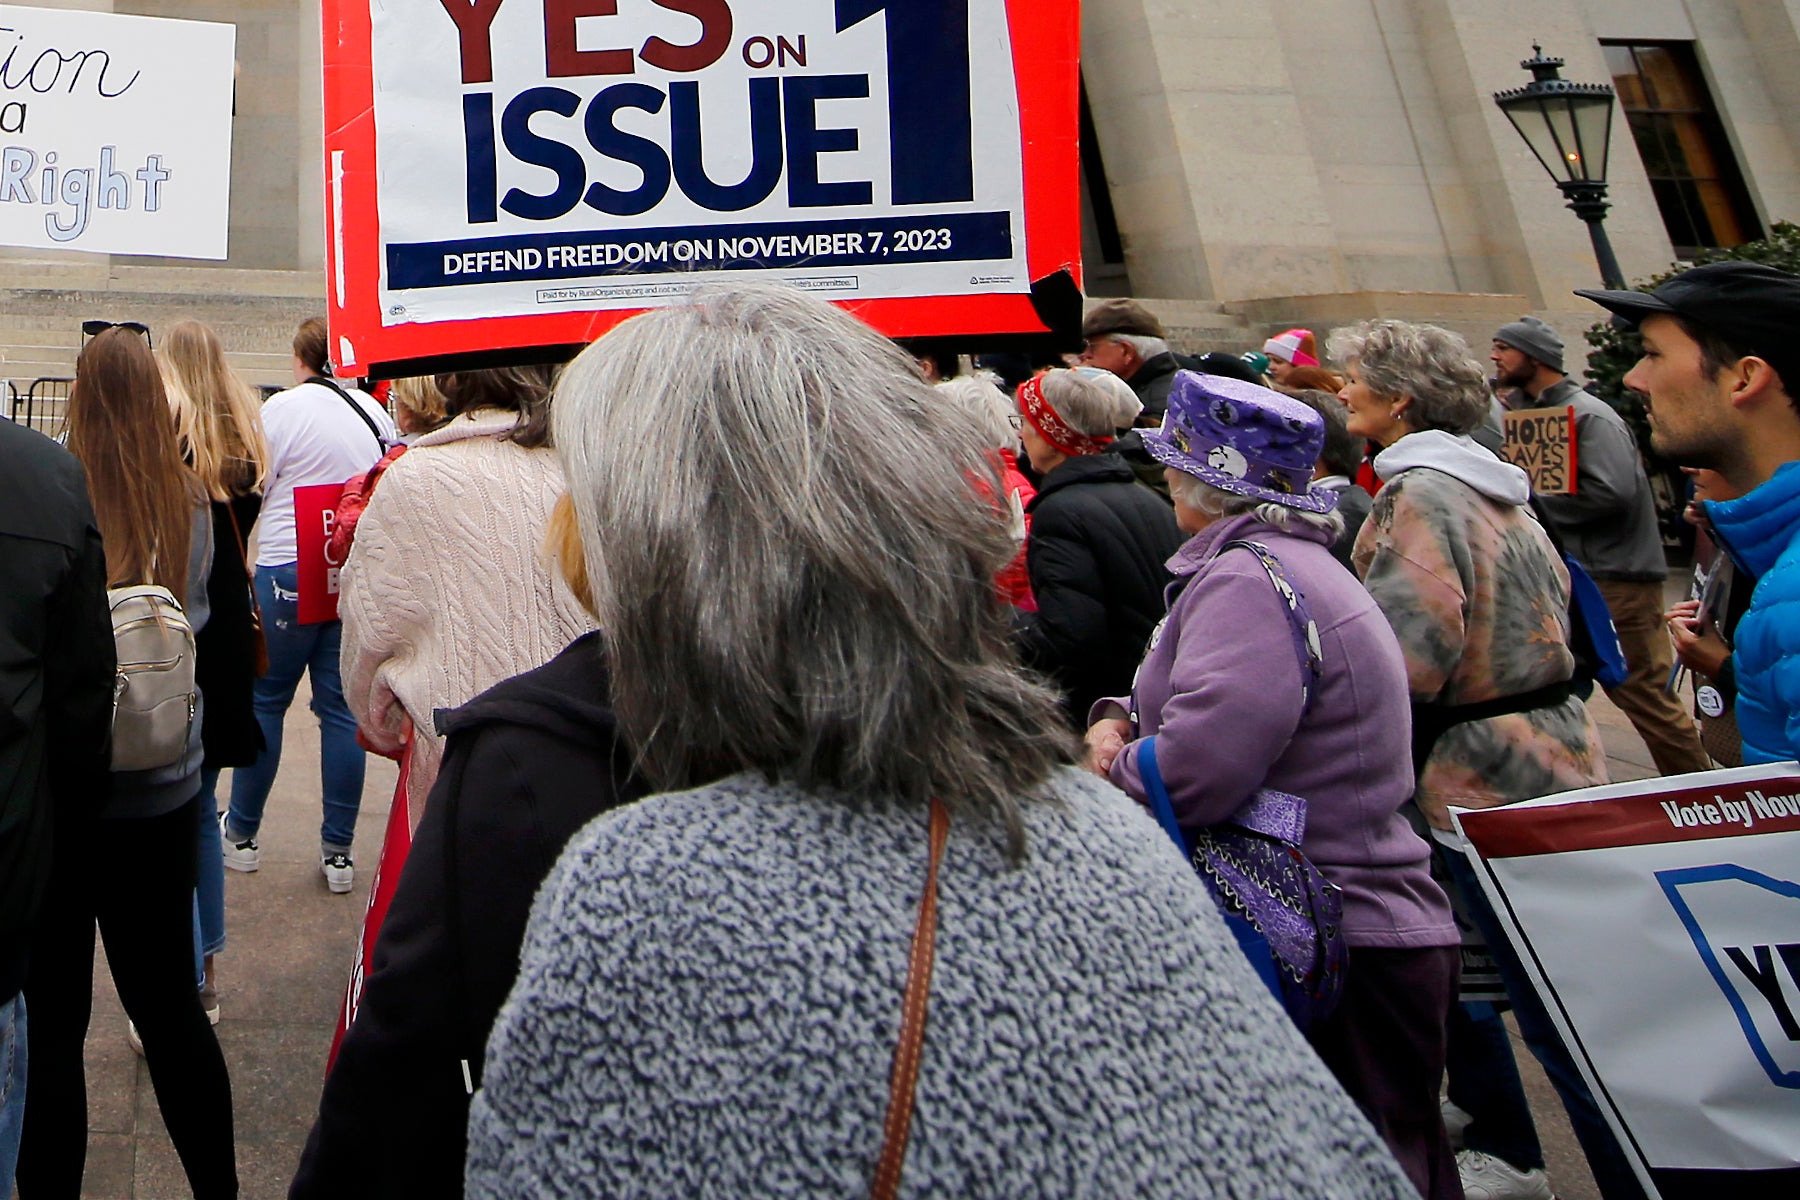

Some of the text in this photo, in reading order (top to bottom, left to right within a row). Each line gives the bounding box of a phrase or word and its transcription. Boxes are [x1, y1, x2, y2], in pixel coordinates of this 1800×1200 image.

[742, 35, 807, 68] ON
[0, 102, 27, 133] a
[462, 74, 874, 224] ISSUE
[0, 146, 172, 242] Right
[443, 228, 952, 275] DEFEND FREEDOM ON NOVEMBER 7, 2023
[1504, 416, 1569, 445] HOICE
[1660, 799, 1722, 828] Vote
[1714, 795, 1753, 827] by
